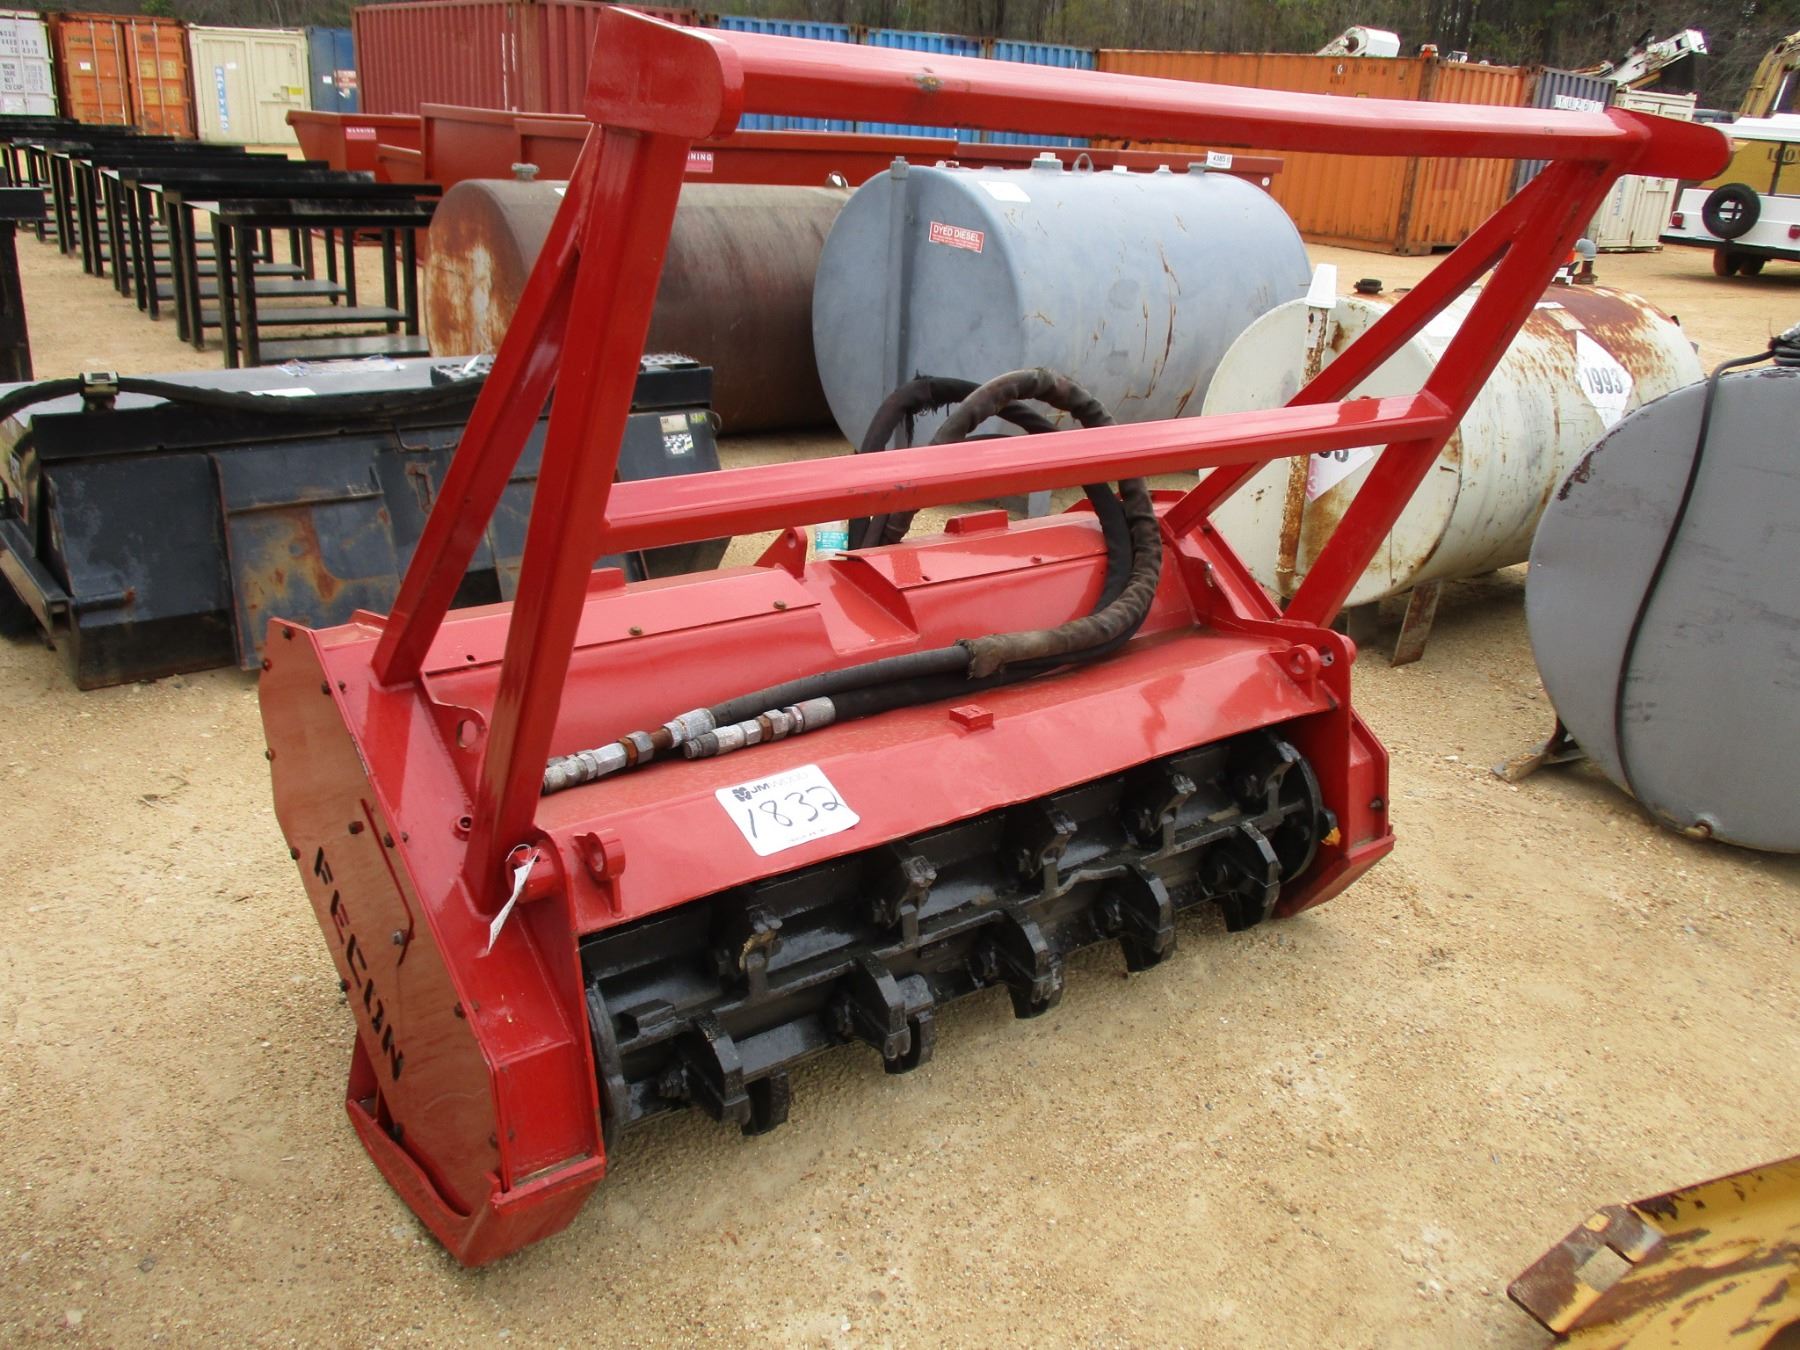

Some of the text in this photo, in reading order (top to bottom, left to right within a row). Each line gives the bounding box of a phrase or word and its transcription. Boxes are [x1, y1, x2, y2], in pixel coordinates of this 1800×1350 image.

[688, 151, 712, 161] NING
[933, 224, 954, 237] DYED
[953, 230, 980, 243] DIESEL
[1584, 367, 1623, 394] 1993
[747, 785, 847, 839] 1832
[313, 846, 404, 1082] FECON
